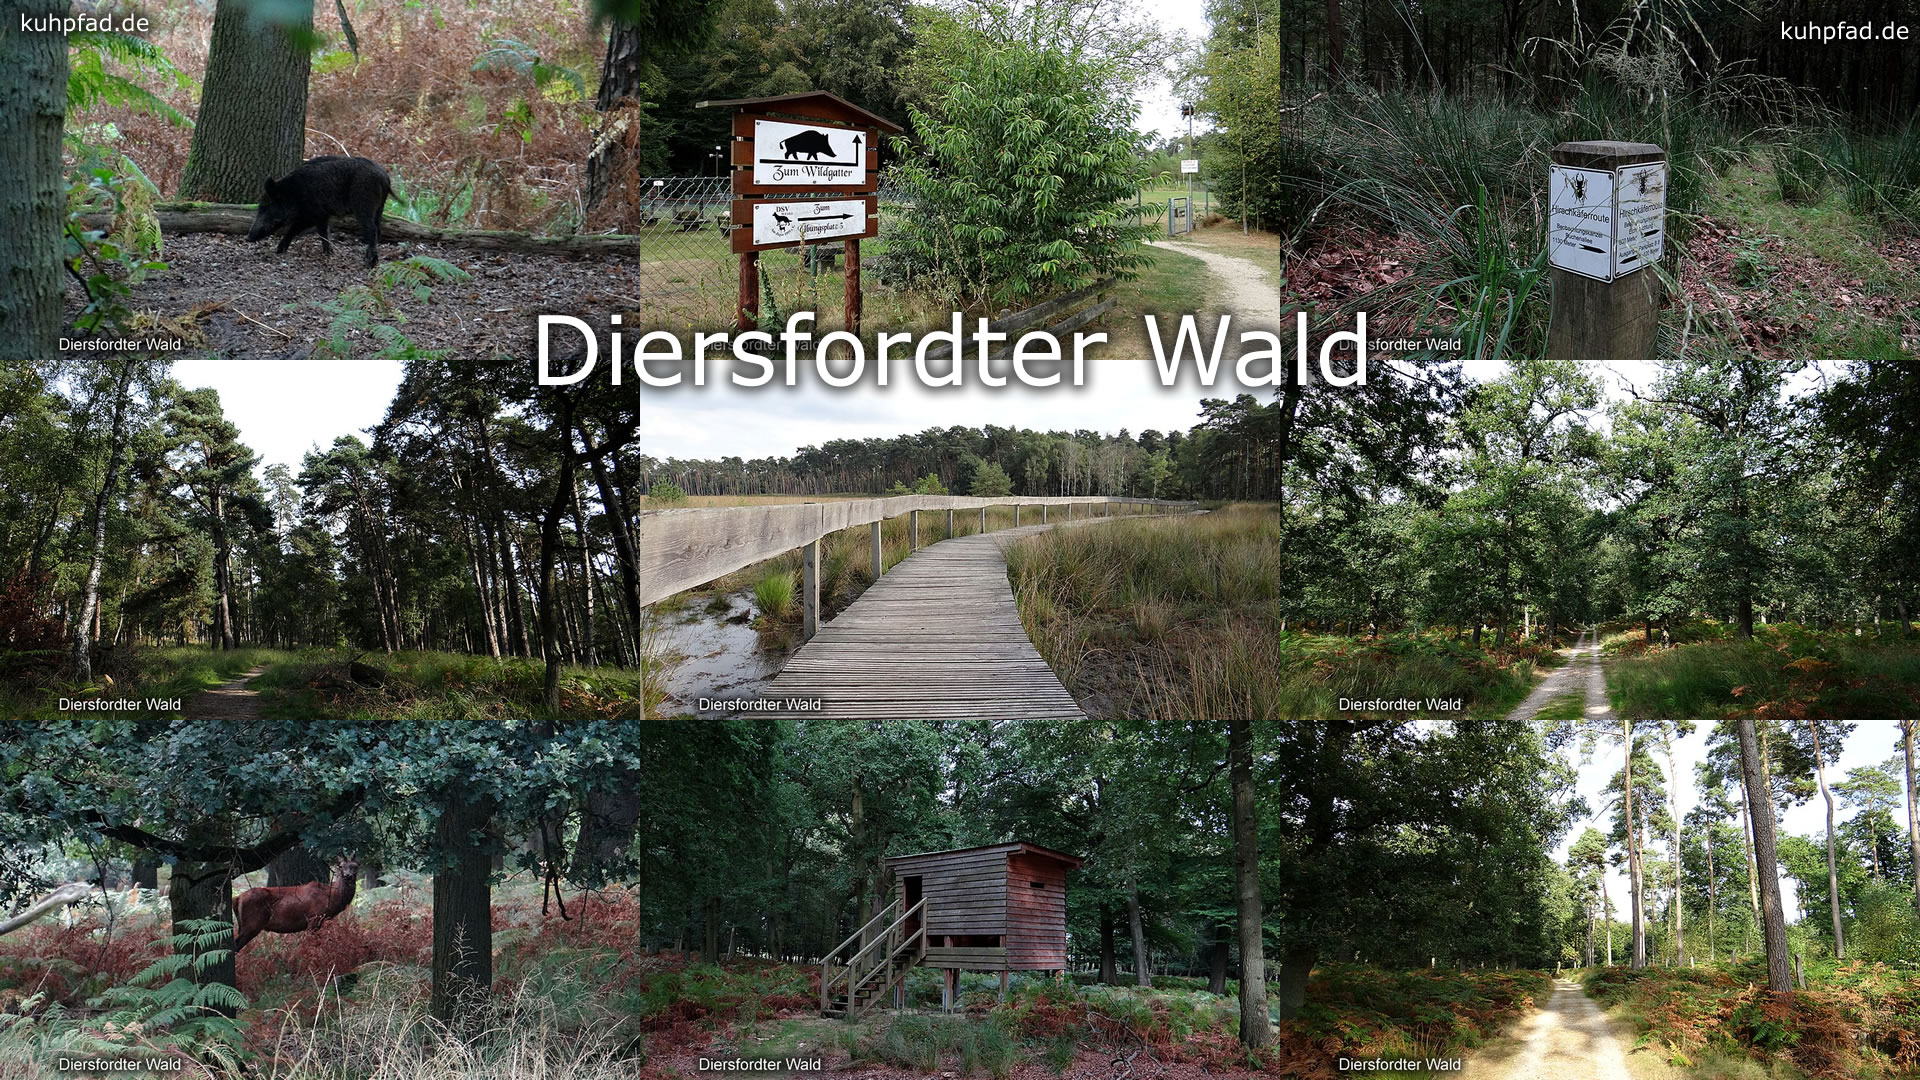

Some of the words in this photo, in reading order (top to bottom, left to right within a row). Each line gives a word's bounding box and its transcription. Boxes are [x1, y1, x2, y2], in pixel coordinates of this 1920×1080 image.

[773, 165, 799, 181] Zum
[802, 165, 853, 181] Wildgatter
[1551, 204, 1610, 224] Hirschkäferroute
